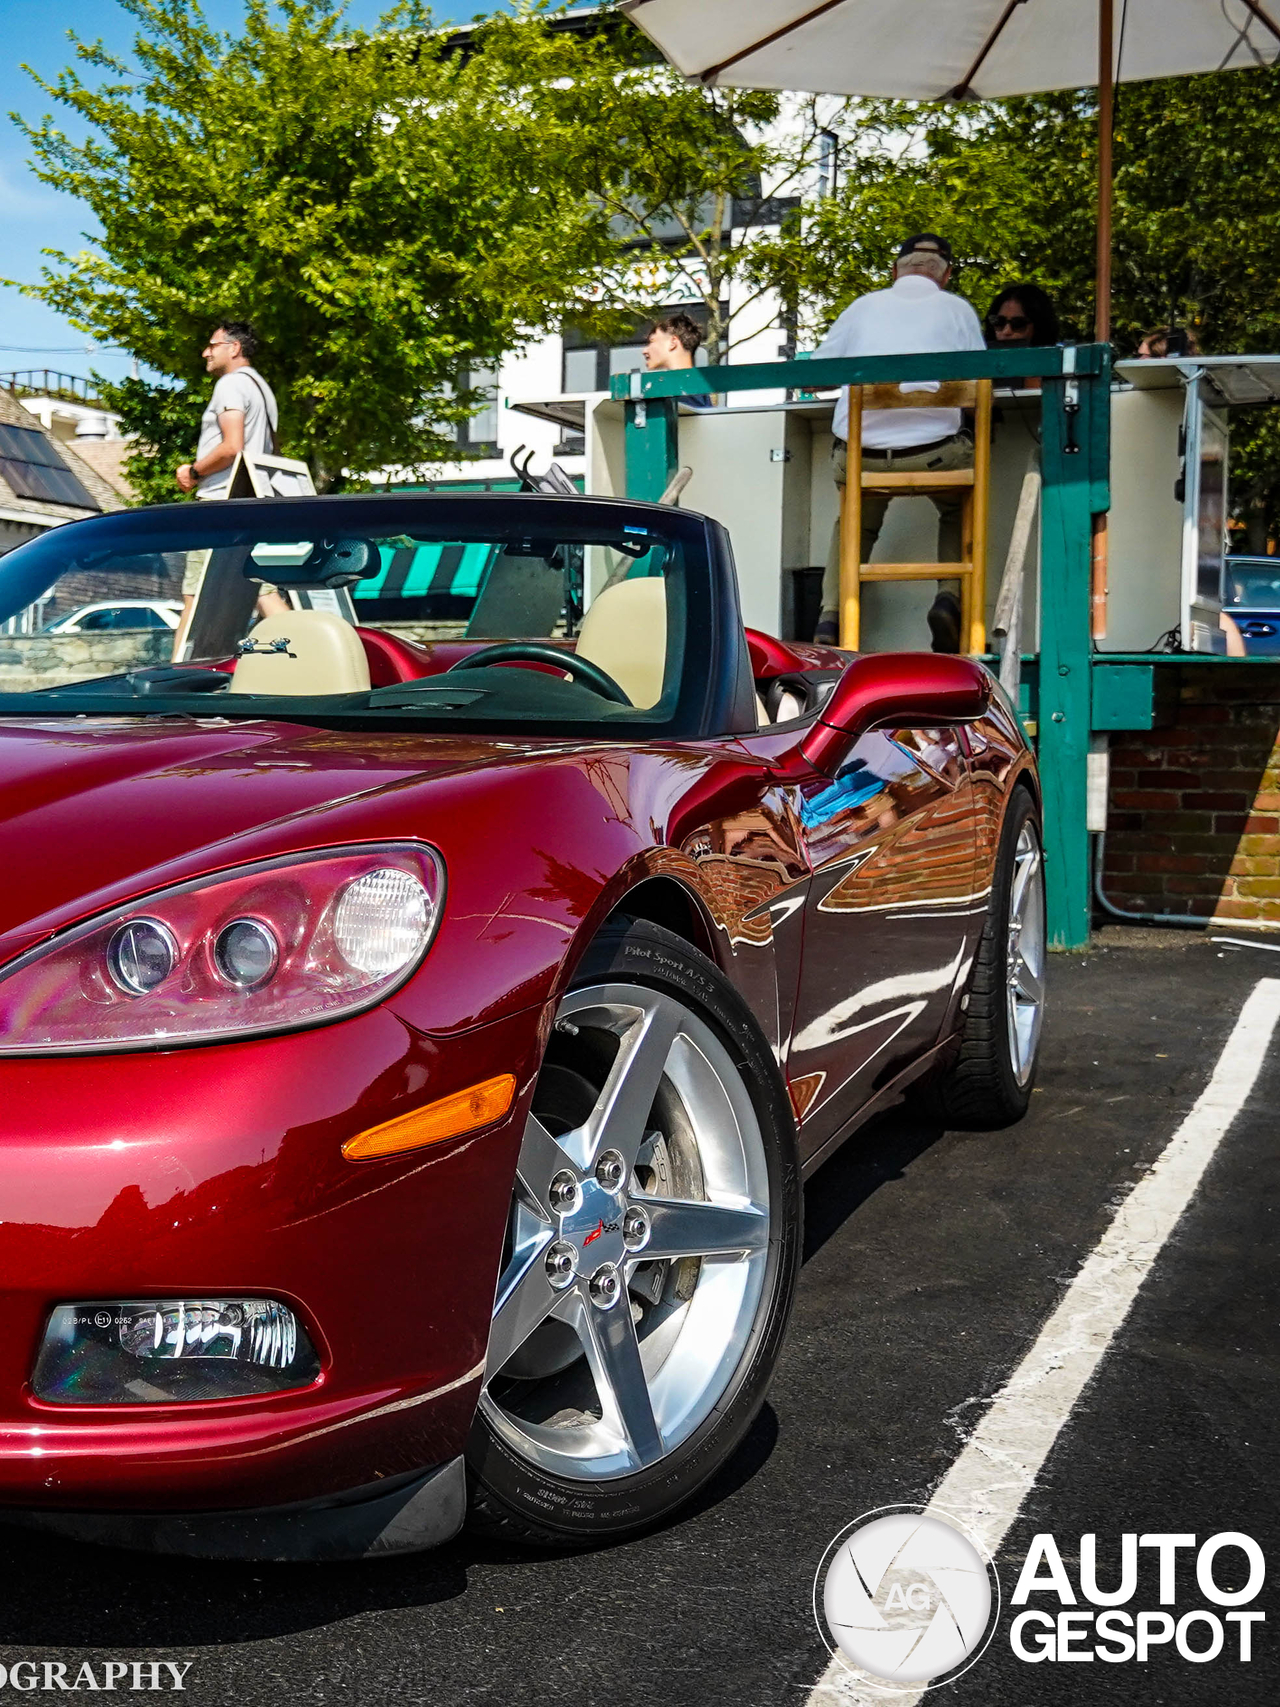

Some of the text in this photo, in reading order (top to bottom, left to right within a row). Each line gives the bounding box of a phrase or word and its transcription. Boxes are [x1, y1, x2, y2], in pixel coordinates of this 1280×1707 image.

[624, 945, 652, 959] Pilot
[652, 952, 685, 971] Sport
[685, 968, 707, 986] A/S
[706, 983, 716, 993] 3
